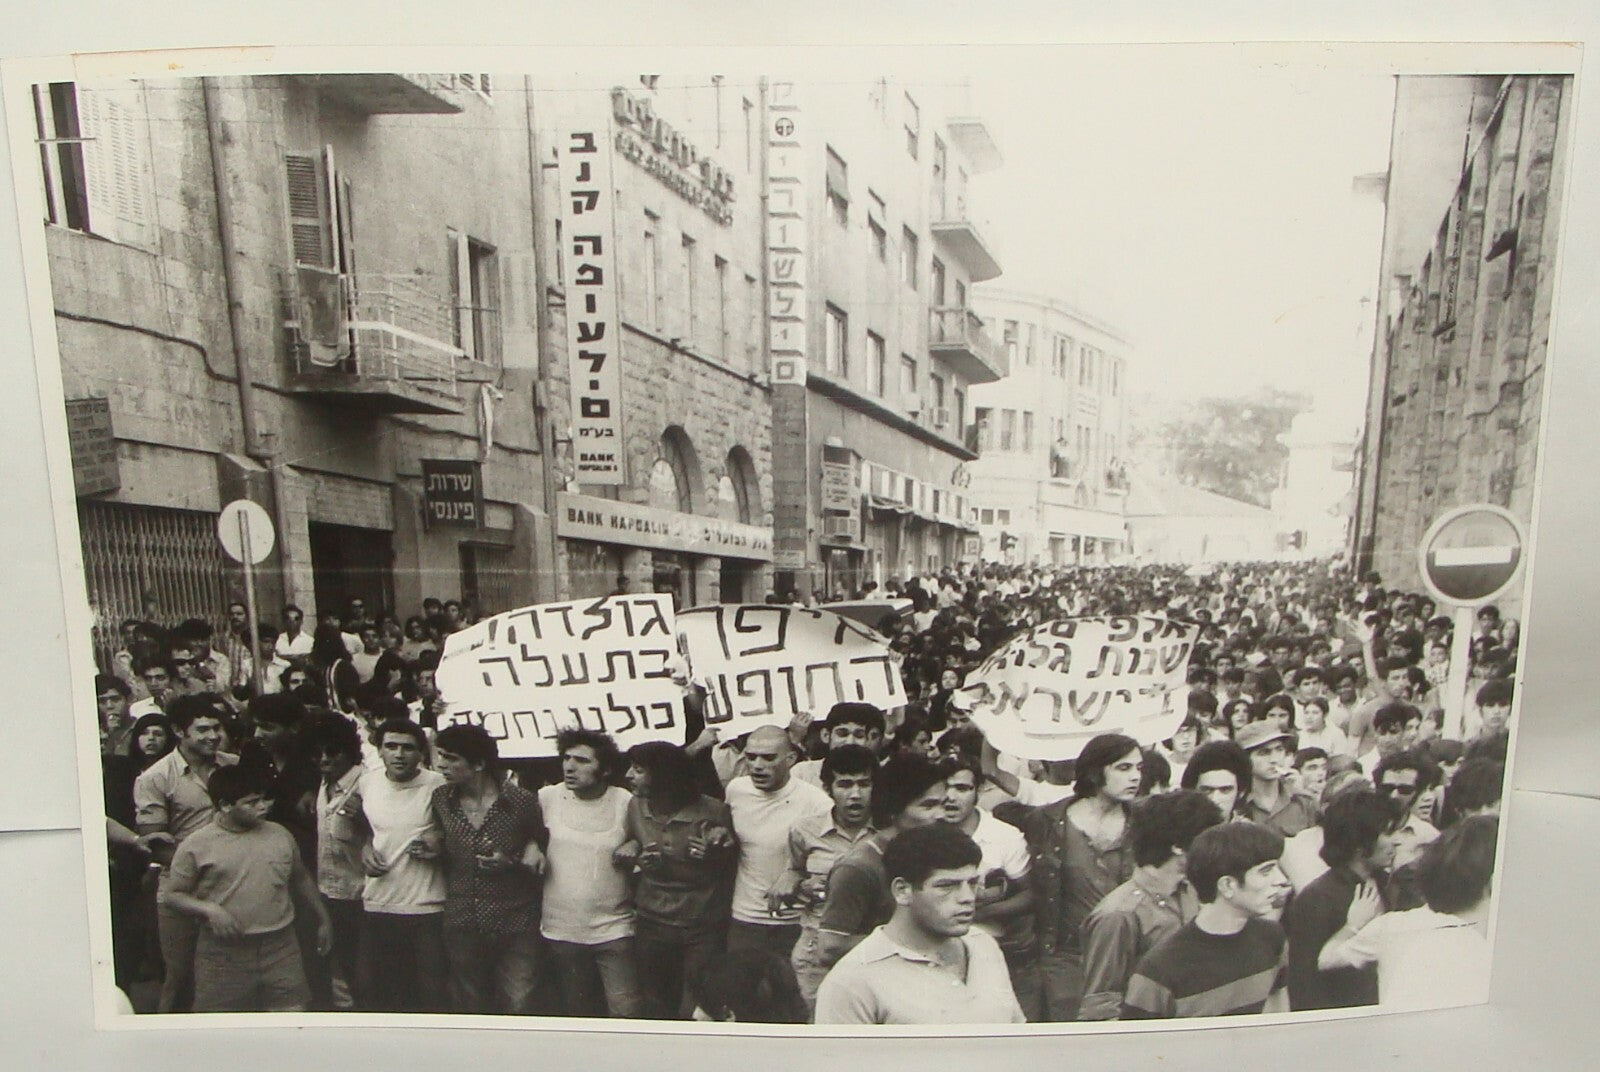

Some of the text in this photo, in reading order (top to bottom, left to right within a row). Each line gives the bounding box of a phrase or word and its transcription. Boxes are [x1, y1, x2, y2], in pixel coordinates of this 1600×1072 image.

[569, 132, 610, 418] בנק הפועלים
[772, 154, 796, 381] ירושלים
[580, 453, 614, 461] BANK
[427, 473, 472, 492] שרות
[429, 501, 474, 520] פיננסי
[568, 507, 603, 527] BANK
[488, 598, 671, 650] גולדה!
[1086, 642, 1190, 679] שנות
[704, 655, 895, 724] החופש
